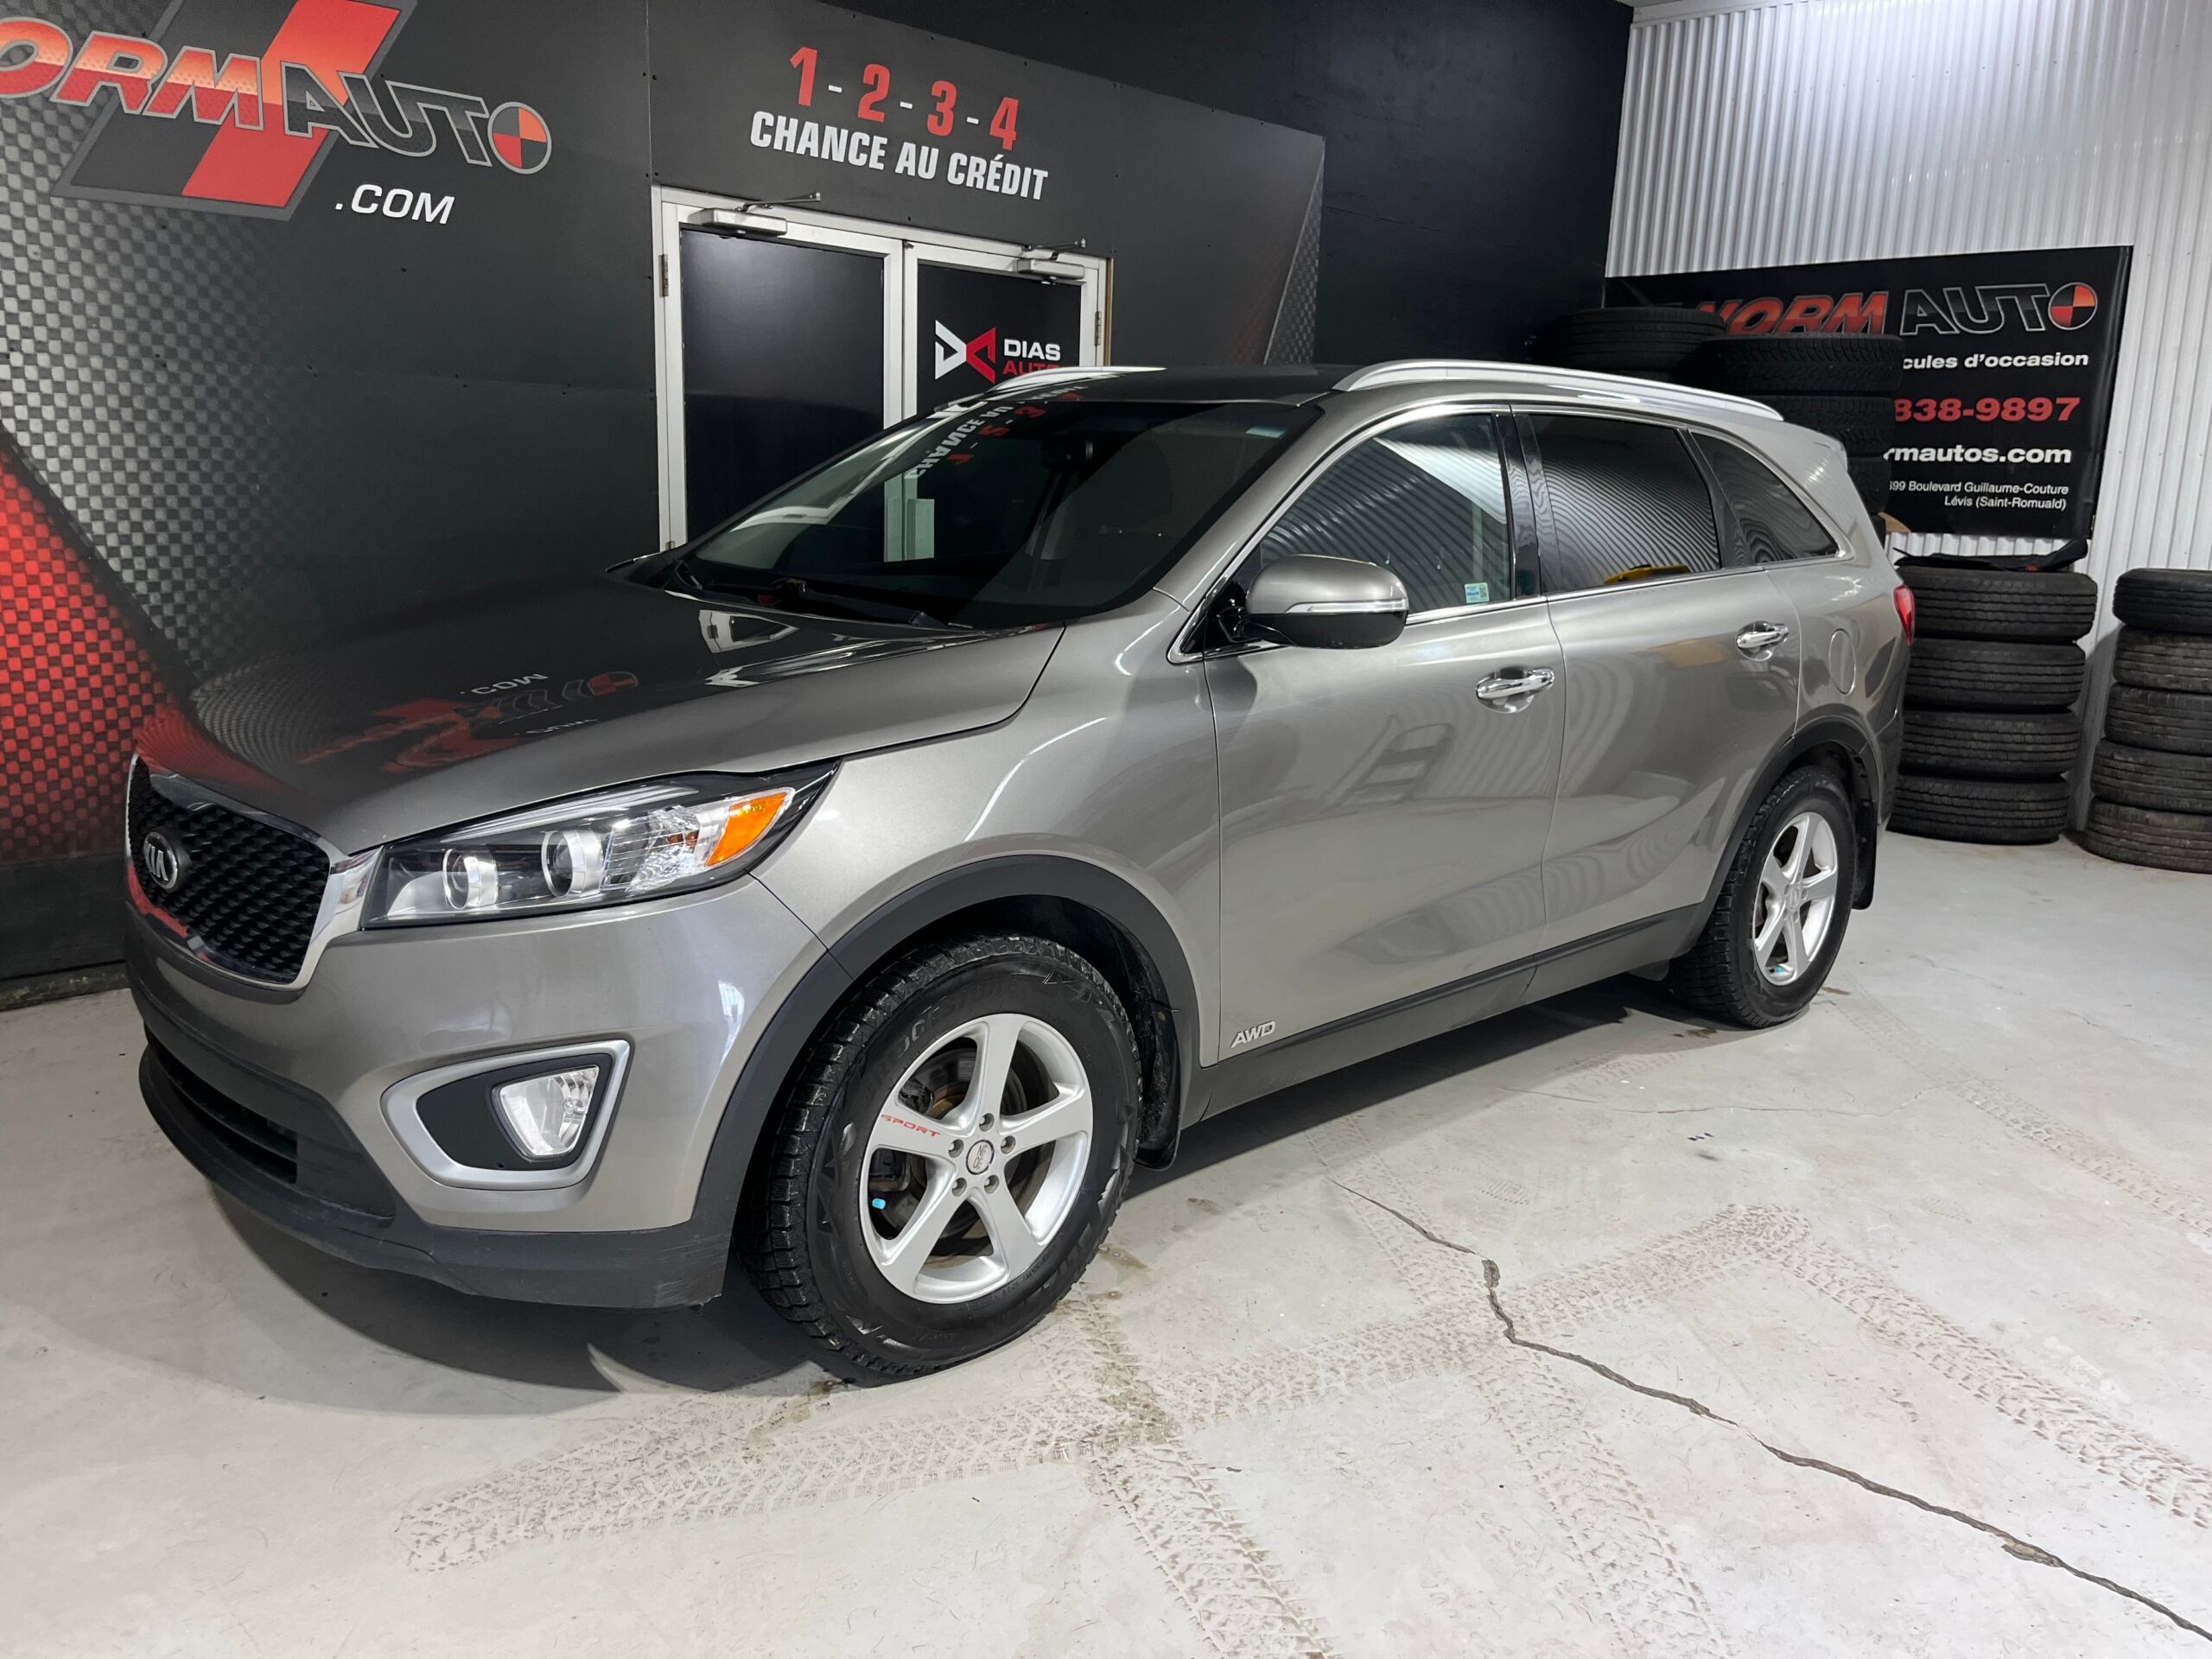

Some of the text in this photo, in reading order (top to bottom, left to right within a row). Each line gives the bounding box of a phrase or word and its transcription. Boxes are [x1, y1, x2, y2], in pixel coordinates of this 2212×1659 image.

[750, 111, 1049, 200] CHANCE AU CRÉDIT
[335, 184, 454, 224] .COM
[1003, 339, 1061, 361] DIAS
[1964, 353, 2089, 368] d'occasion
[1002, 359, 1062, 375] AUT
[1908, 480, 1961, 493] Boulevard
[1964, 481, 2069, 495] Guillaume-Couture
[1944, 495, 2067, 511] Lévis (Saint-Romuald)
[1230, 1020, 1276, 1048] AWD
[880, 1115, 941, 1137] SPORT
